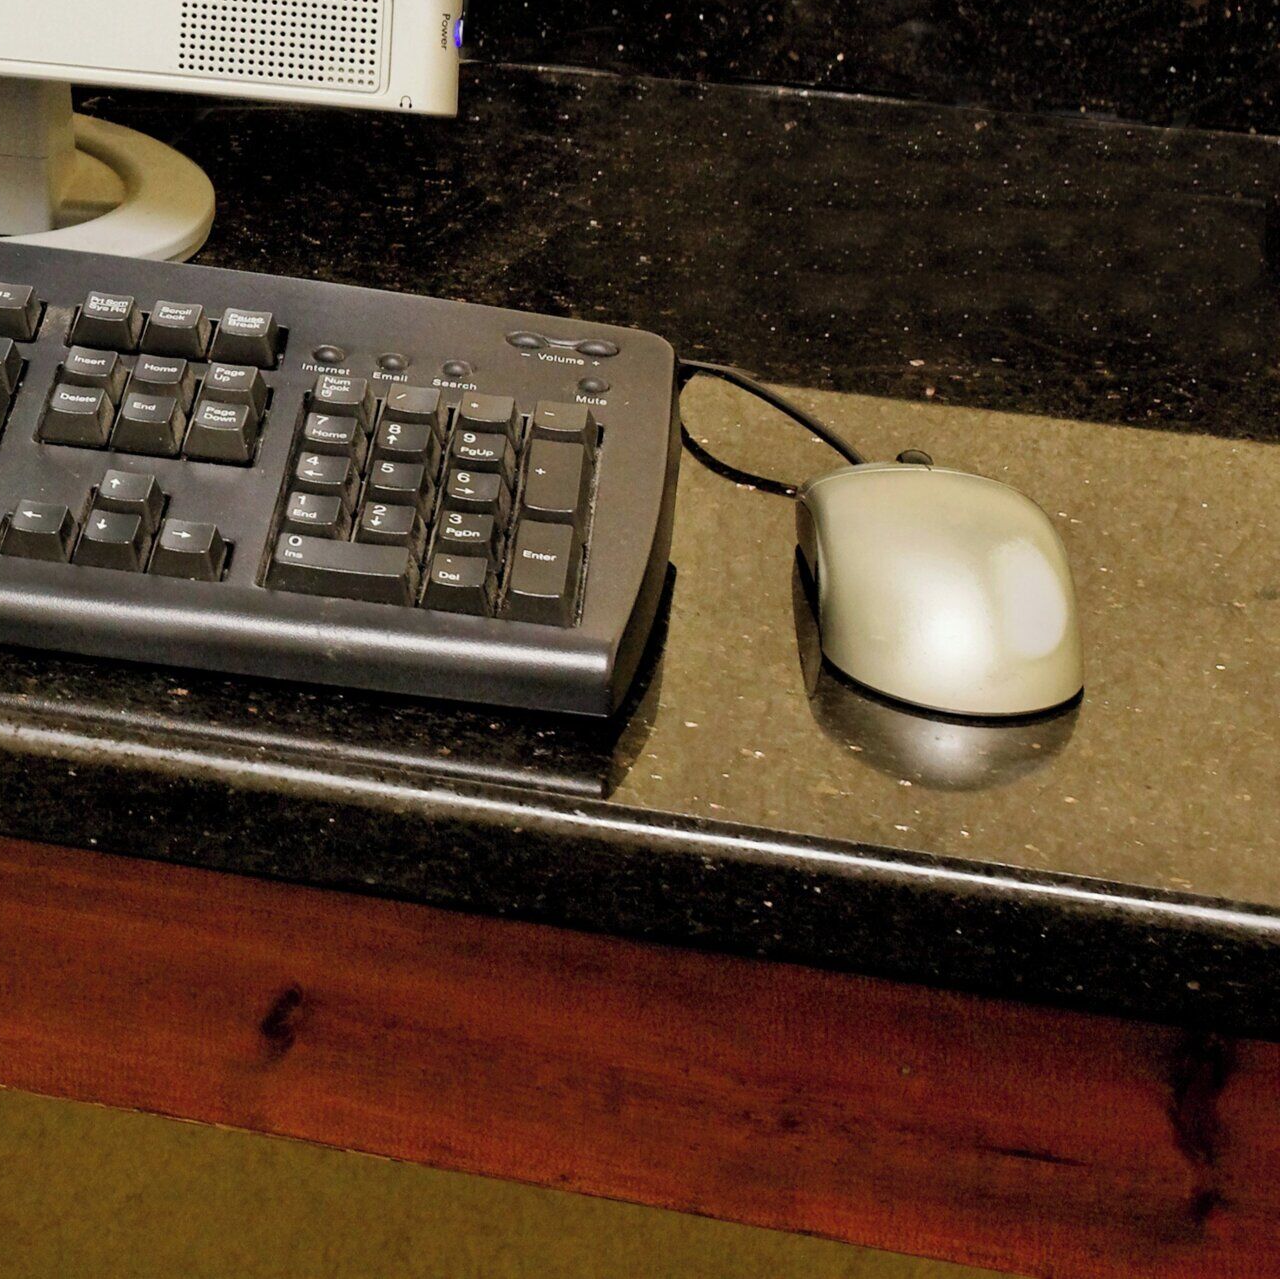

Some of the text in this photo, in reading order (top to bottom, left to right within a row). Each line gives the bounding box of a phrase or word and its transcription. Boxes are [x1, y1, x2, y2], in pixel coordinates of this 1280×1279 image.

[441, 13, 451, 51] Power
[161, 306, 192, 316] Scroll
[159, 312, 186, 321] Lock
[74, 355, 106, 366] Insert
[538, 352, 585, 366] Volume
[144, 362, 178, 372] Home
[301, 363, 351, 376] Internet
[216, 367, 245, 378] Page
[372, 371, 408, 383] Email
[214, 373, 231, 383] Up
[324, 377, 351, 386] Num
[322, 383, 351, 393] Lock
[432, 378, 477, 391] Search
[60, 392, 97, 403] Delete
[575, 394, 608, 406] Mute
[133, 401, 157, 411] End
[206, 406, 236, 416] Page
[203, 413, 237, 423] Down
[316, 415, 329, 425] 7
[312, 428, 347, 439] Home
[389, 424, 401, 434] 8
[463, 433, 476, 443] 9
[460, 446, 494, 458] PgUp
[305, 456, 319, 466] 4
[381, 463, 394, 473] 5
[457, 472, 470, 483] 6
[297, 495, 306, 505] 1
[292, 509, 317, 519] End
[372, 505, 386, 516] 2
[449, 514, 463, 525] 3
[446, 528, 480, 538] PgDn
[288, 536, 302, 547] 0
[284, 549, 303, 559] Ins
[523, 549, 557, 563] Enter
[439, 571, 460, 581] Del
